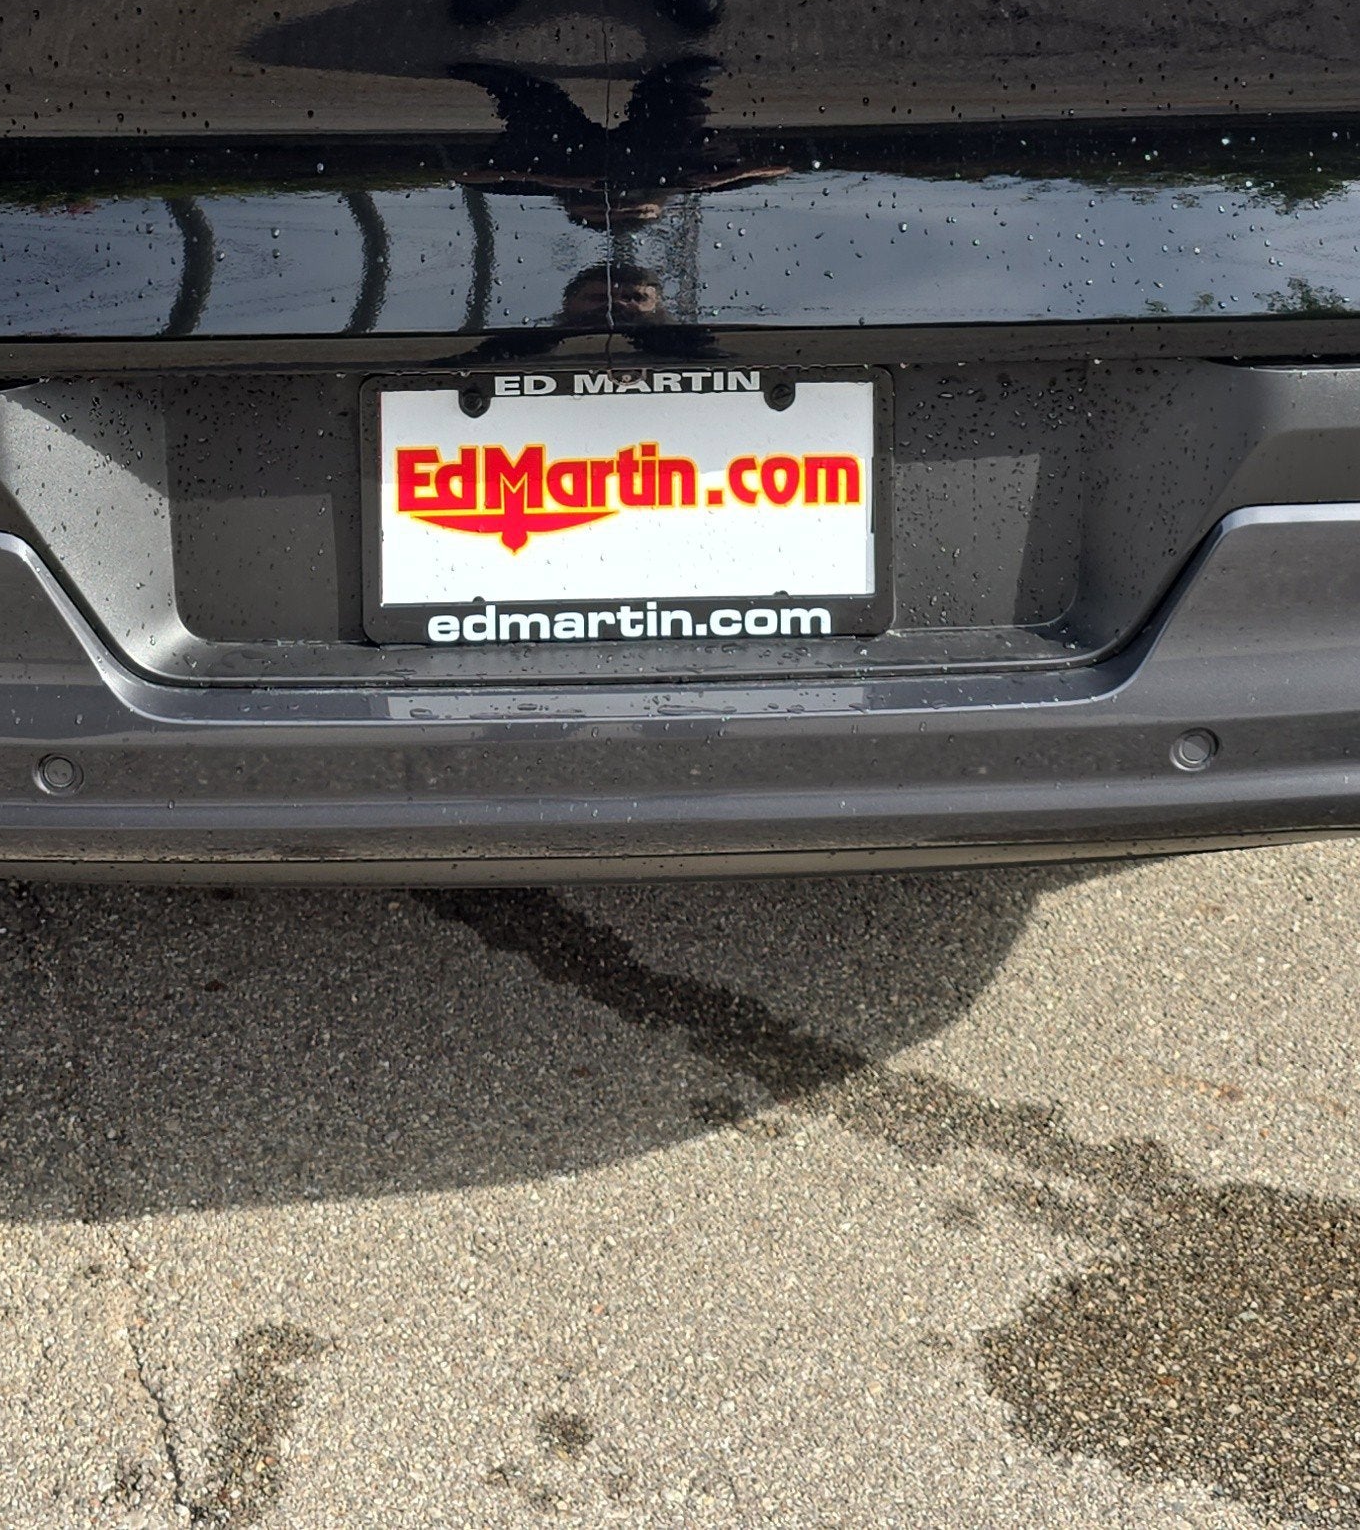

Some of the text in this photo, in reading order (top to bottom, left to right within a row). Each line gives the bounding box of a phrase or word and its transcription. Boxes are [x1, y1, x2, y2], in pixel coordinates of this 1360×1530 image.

[494, 375, 558, 397] ED
[394, 441, 861, 513] EdMartin.com
[427, 601, 832, 643] edmartin.com
